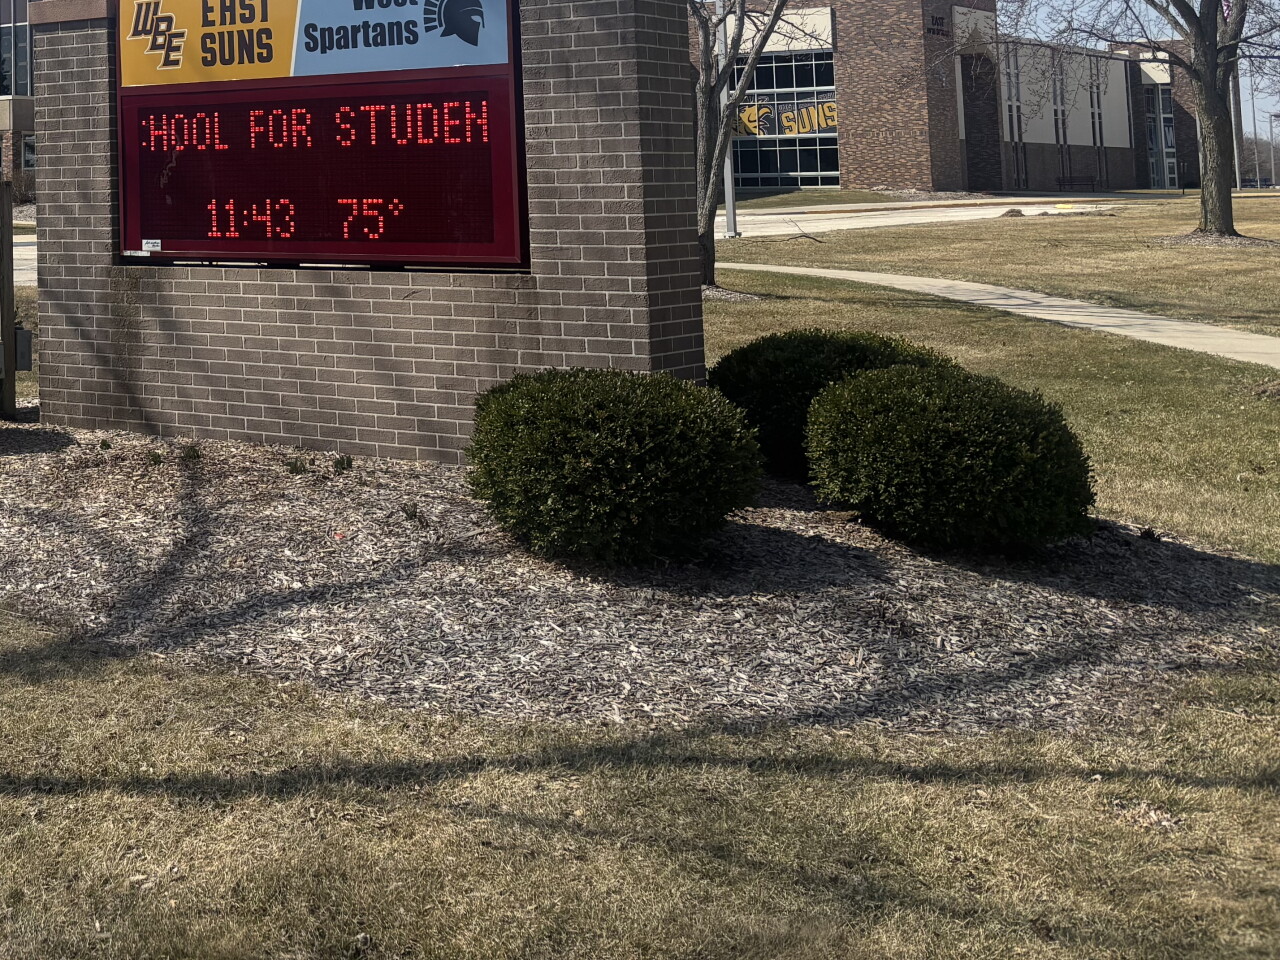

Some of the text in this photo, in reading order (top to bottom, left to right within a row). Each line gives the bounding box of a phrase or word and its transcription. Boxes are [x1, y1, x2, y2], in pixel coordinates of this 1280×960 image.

[201, 28, 274, 67] SUNS
[304, 20, 419, 55] Spartans
[249, 108, 312, 149] FOR
[335, 100, 489, 146] STUDEN
[781, 102, 838, 136] SUNS
[207, 199, 295, 238] 11:43
